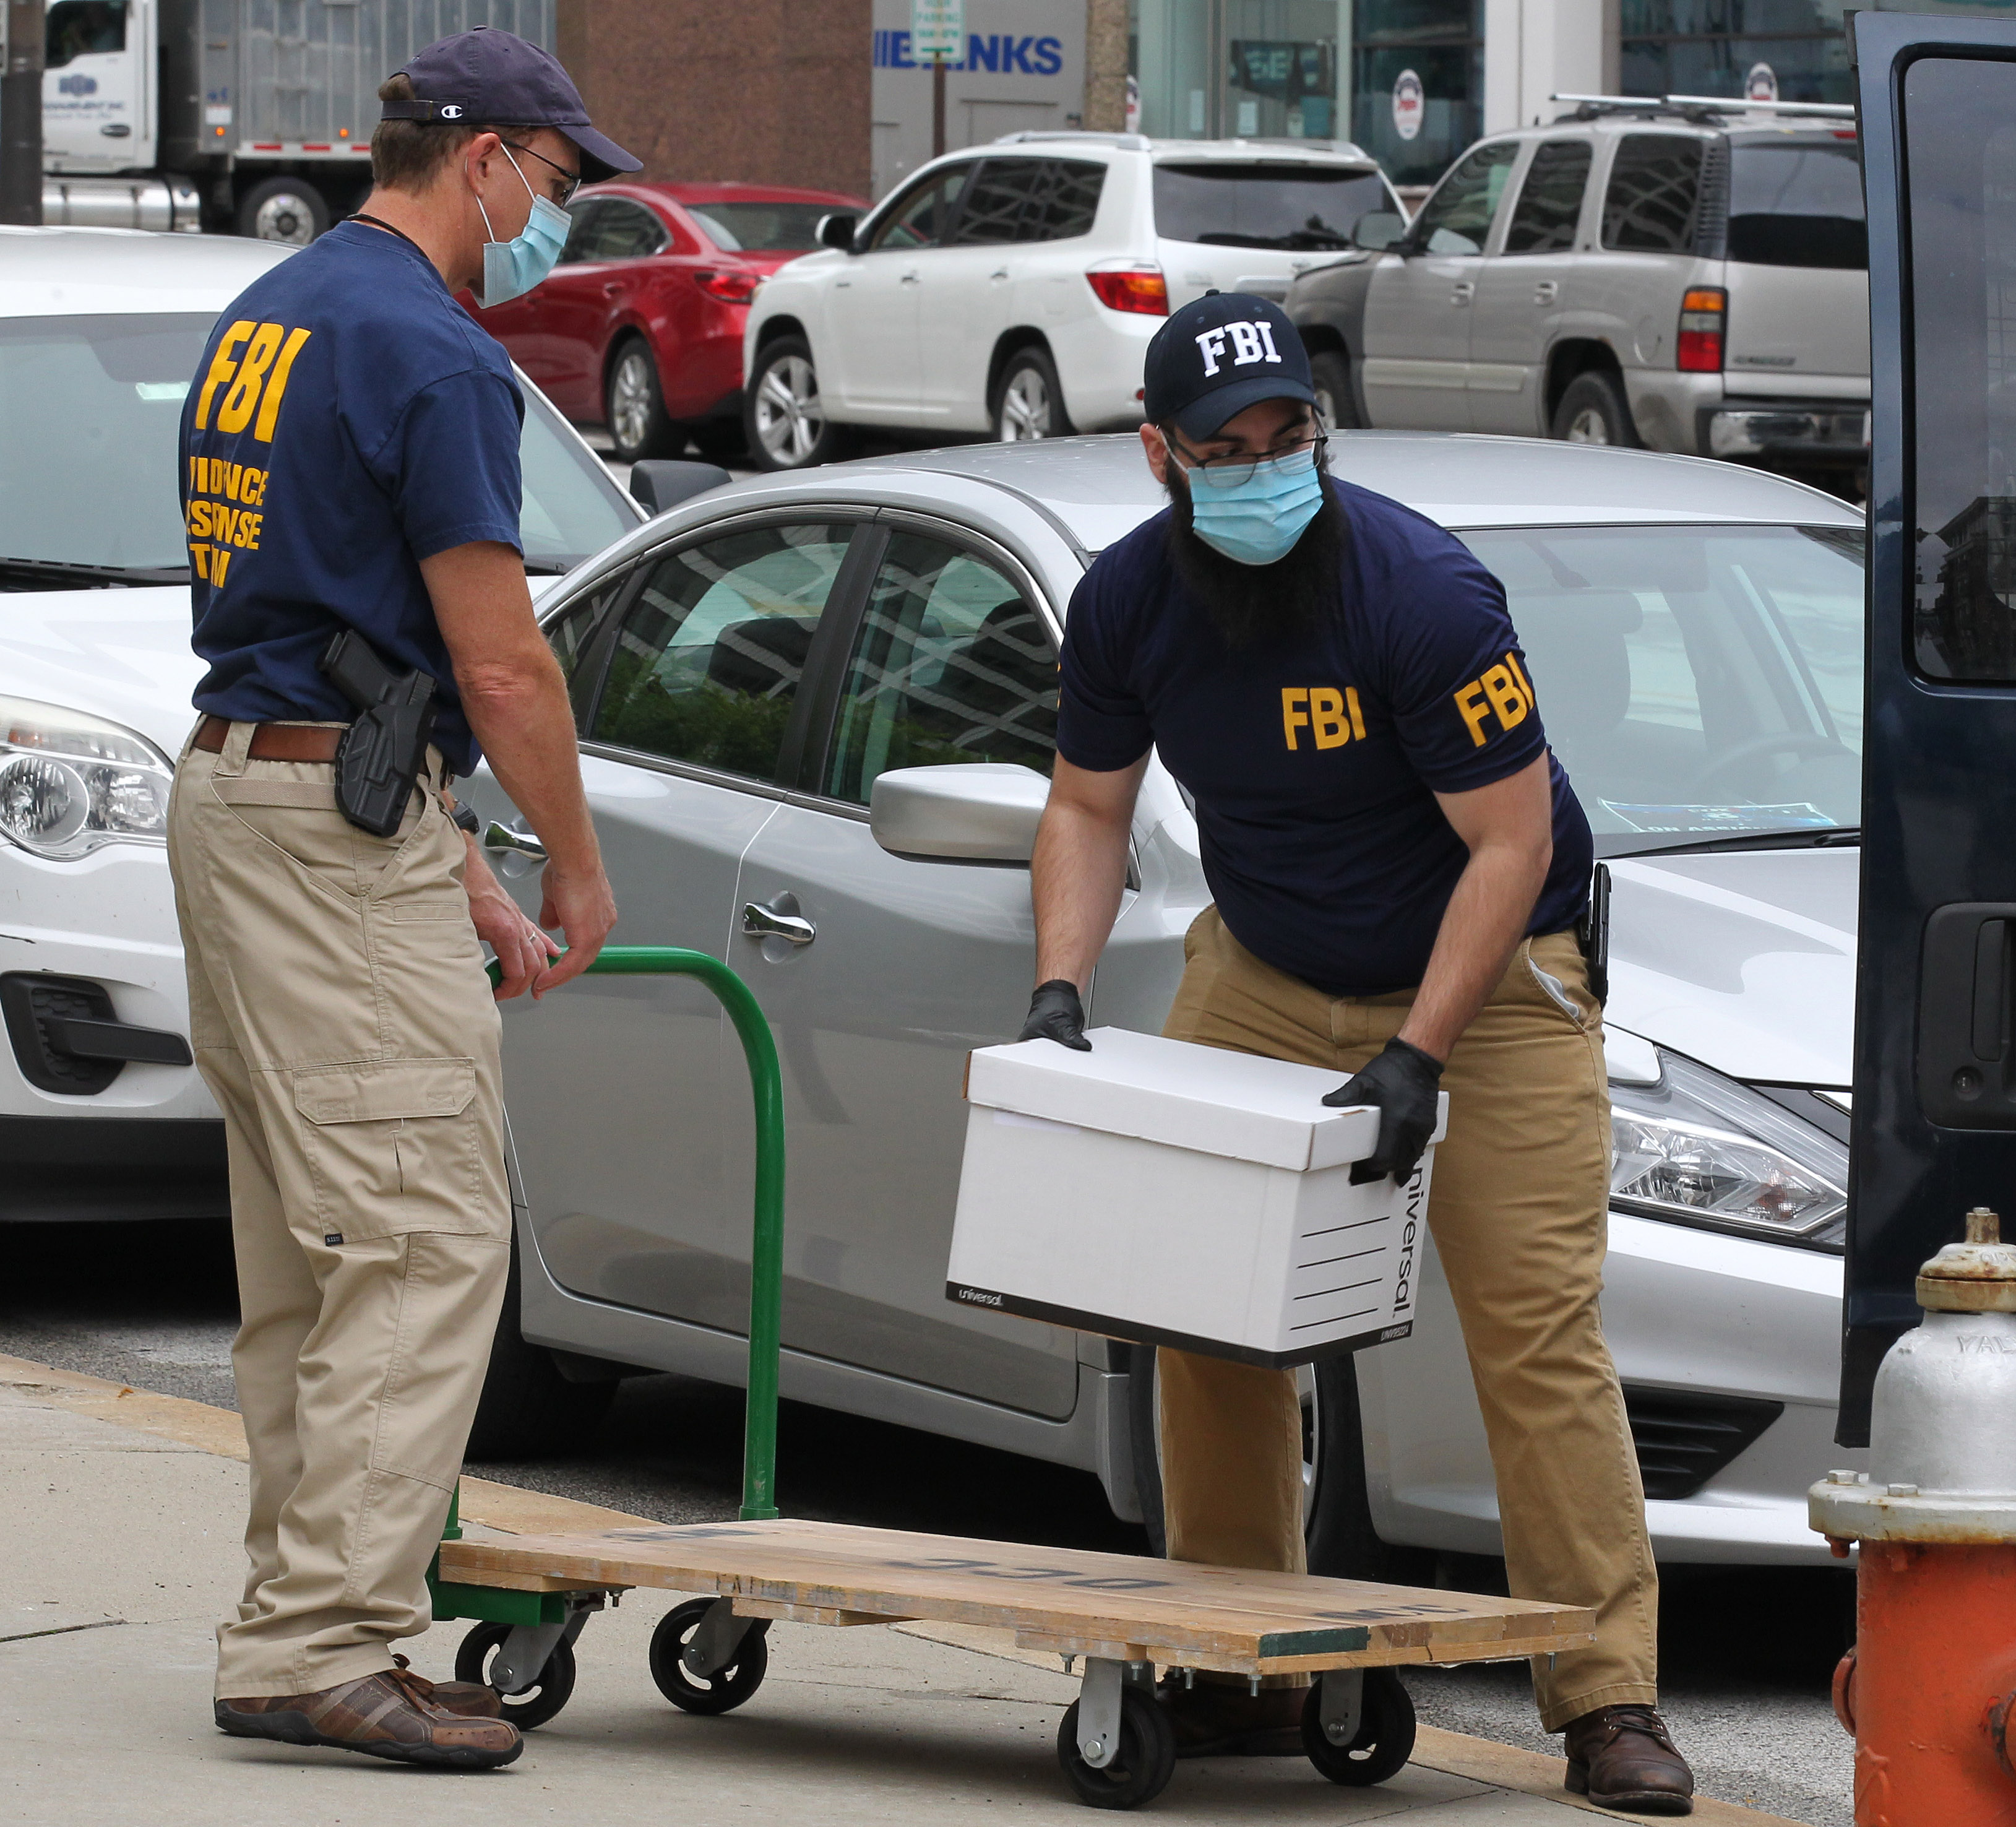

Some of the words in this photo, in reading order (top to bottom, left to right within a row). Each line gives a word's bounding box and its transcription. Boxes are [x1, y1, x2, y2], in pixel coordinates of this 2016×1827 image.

[194, 320, 312, 443] FBI
[1195, 321, 1282, 378] FBI
[1282, 686, 1366, 751] FBI
[1454, 651, 1534, 748] FBI
[1394, 1167, 1424, 1313] niversal
